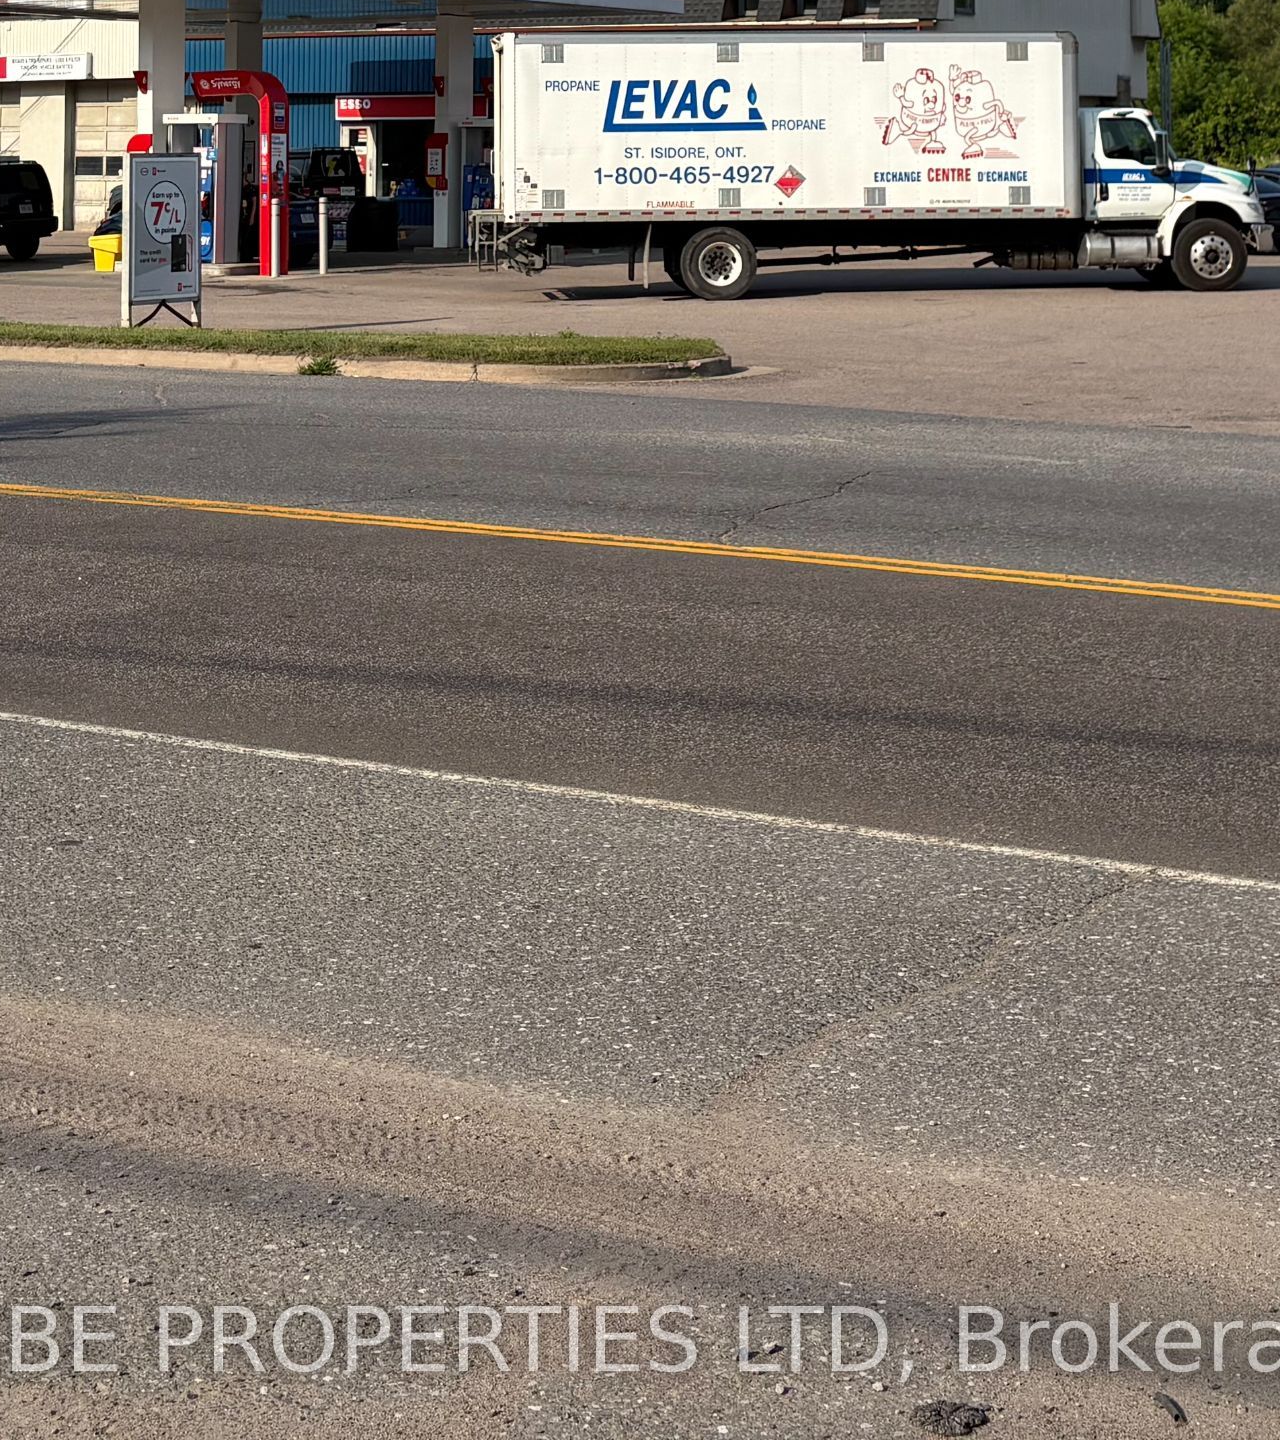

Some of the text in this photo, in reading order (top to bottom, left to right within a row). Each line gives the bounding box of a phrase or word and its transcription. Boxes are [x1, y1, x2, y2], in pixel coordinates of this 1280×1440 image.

[545, 80, 600, 92] PROPANE
[339, 99, 371, 110] ESSO
[603, 79, 732, 132] LEVAC
[771, 119, 827, 131] PROPANE
[624, 146, 747, 160] ST. ISIDORE, ONT.
[593, 165, 775, 185] 1-800-465-4927
[873, 167, 1028, 183] EXCHANGE CENTRE D'ECHANGE
[646, 200, 696, 209] FLAMMABLE
[160, 227, 177, 236] points
